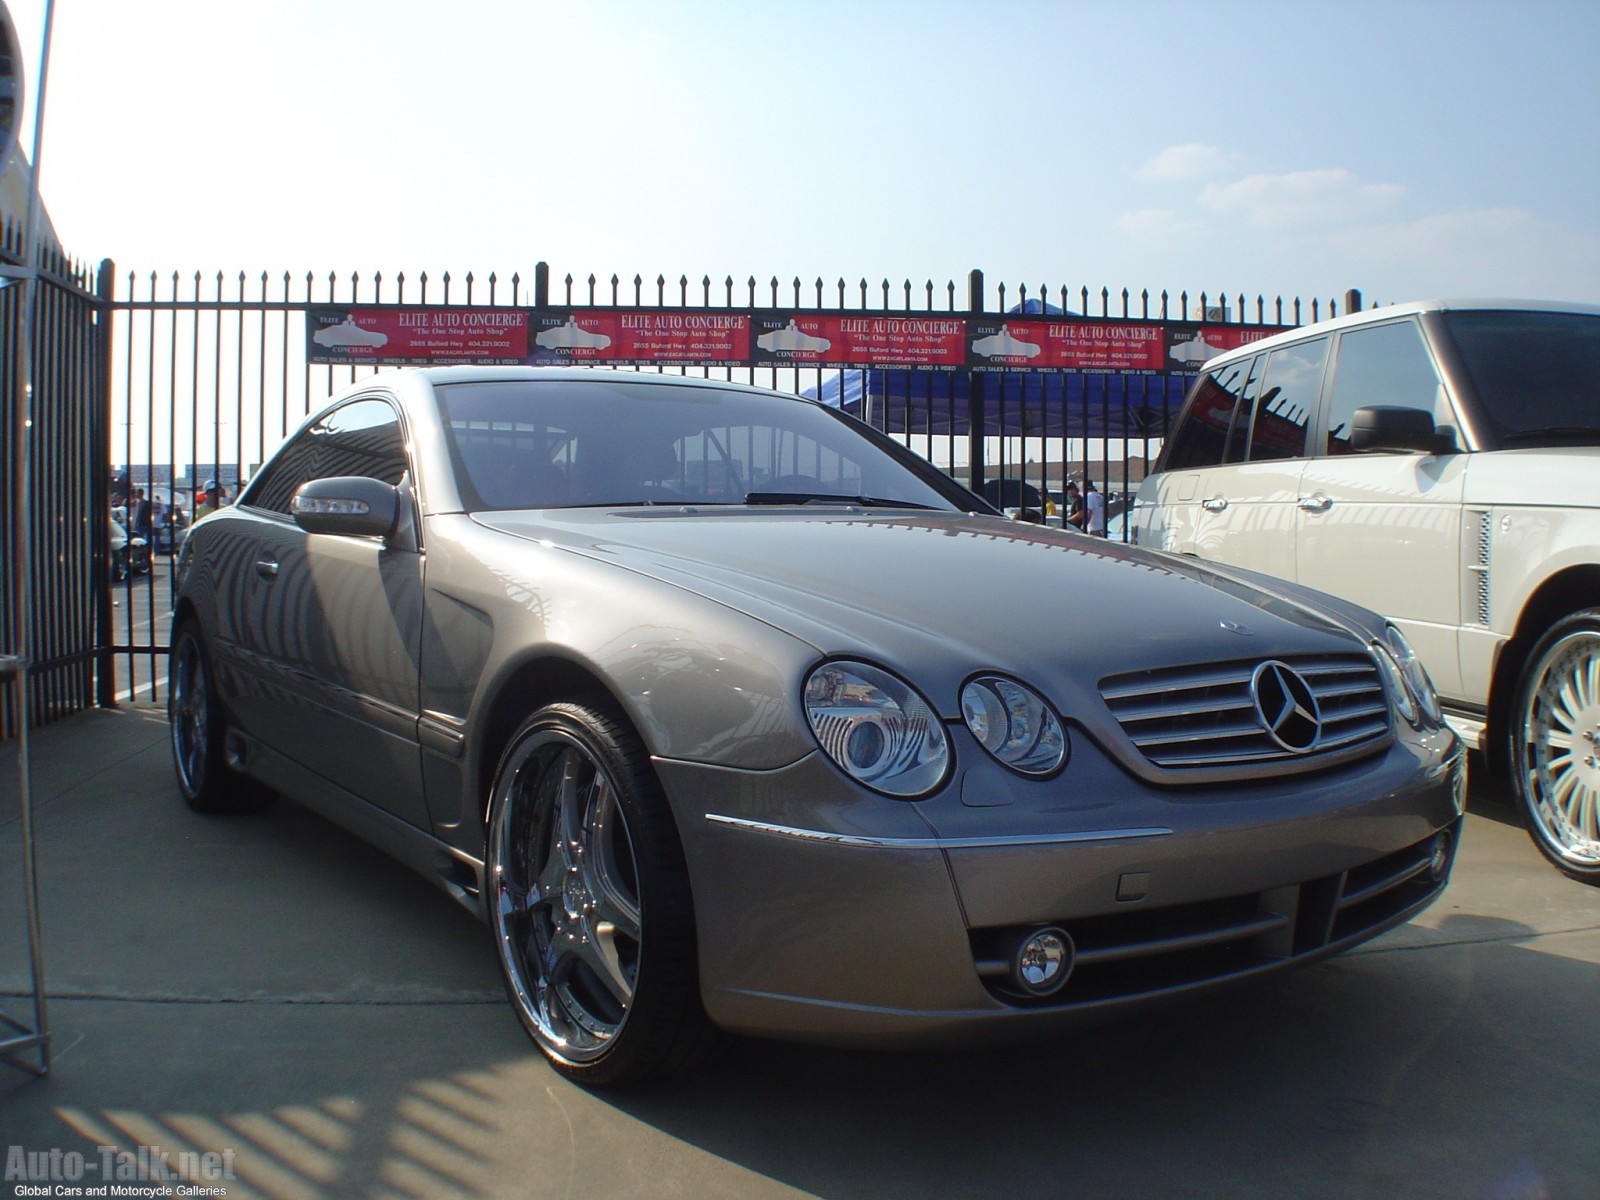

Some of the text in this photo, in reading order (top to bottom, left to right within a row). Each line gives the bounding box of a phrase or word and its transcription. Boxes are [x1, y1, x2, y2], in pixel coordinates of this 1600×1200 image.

[399, 313, 523, 327] ELITE AUTO CONCIERGE
[621, 315, 744, 329] ELITE AUTO CONCIERGE
[840, 319, 960, 334] ELITE AUTO CONCIERGE
[448, 328, 465, 336] Stop
[671, 330, 687, 338] Stop
[1049, 325, 1158, 340] ELITE AUTO CONCIERGE
[1094, 340, 1108, 348] Stop
